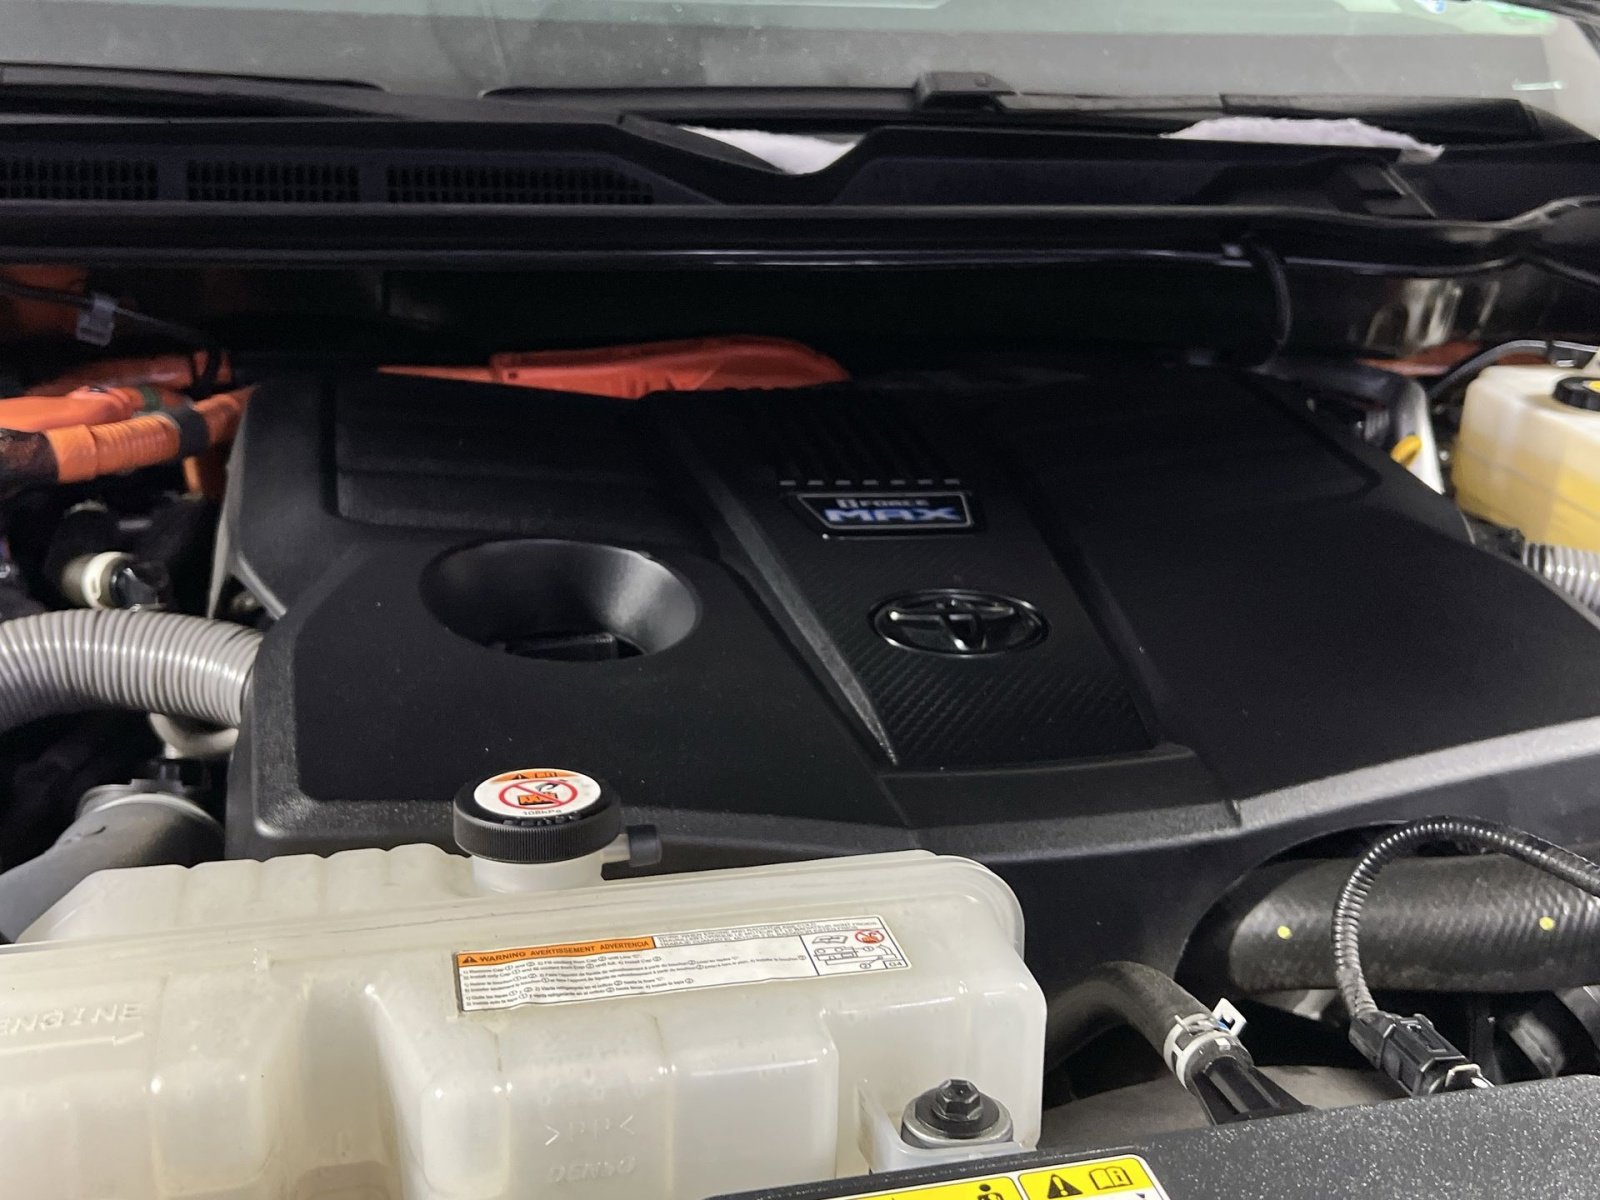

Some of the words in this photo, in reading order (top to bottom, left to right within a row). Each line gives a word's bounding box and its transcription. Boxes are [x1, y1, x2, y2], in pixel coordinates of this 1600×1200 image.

[825, 507, 961, 522] MAX
[480, 951, 526, 962] WARNING
[530, 945, 595, 956] AVERTISSEMENT
[600, 940, 649, 950] ADVERTENCIA
